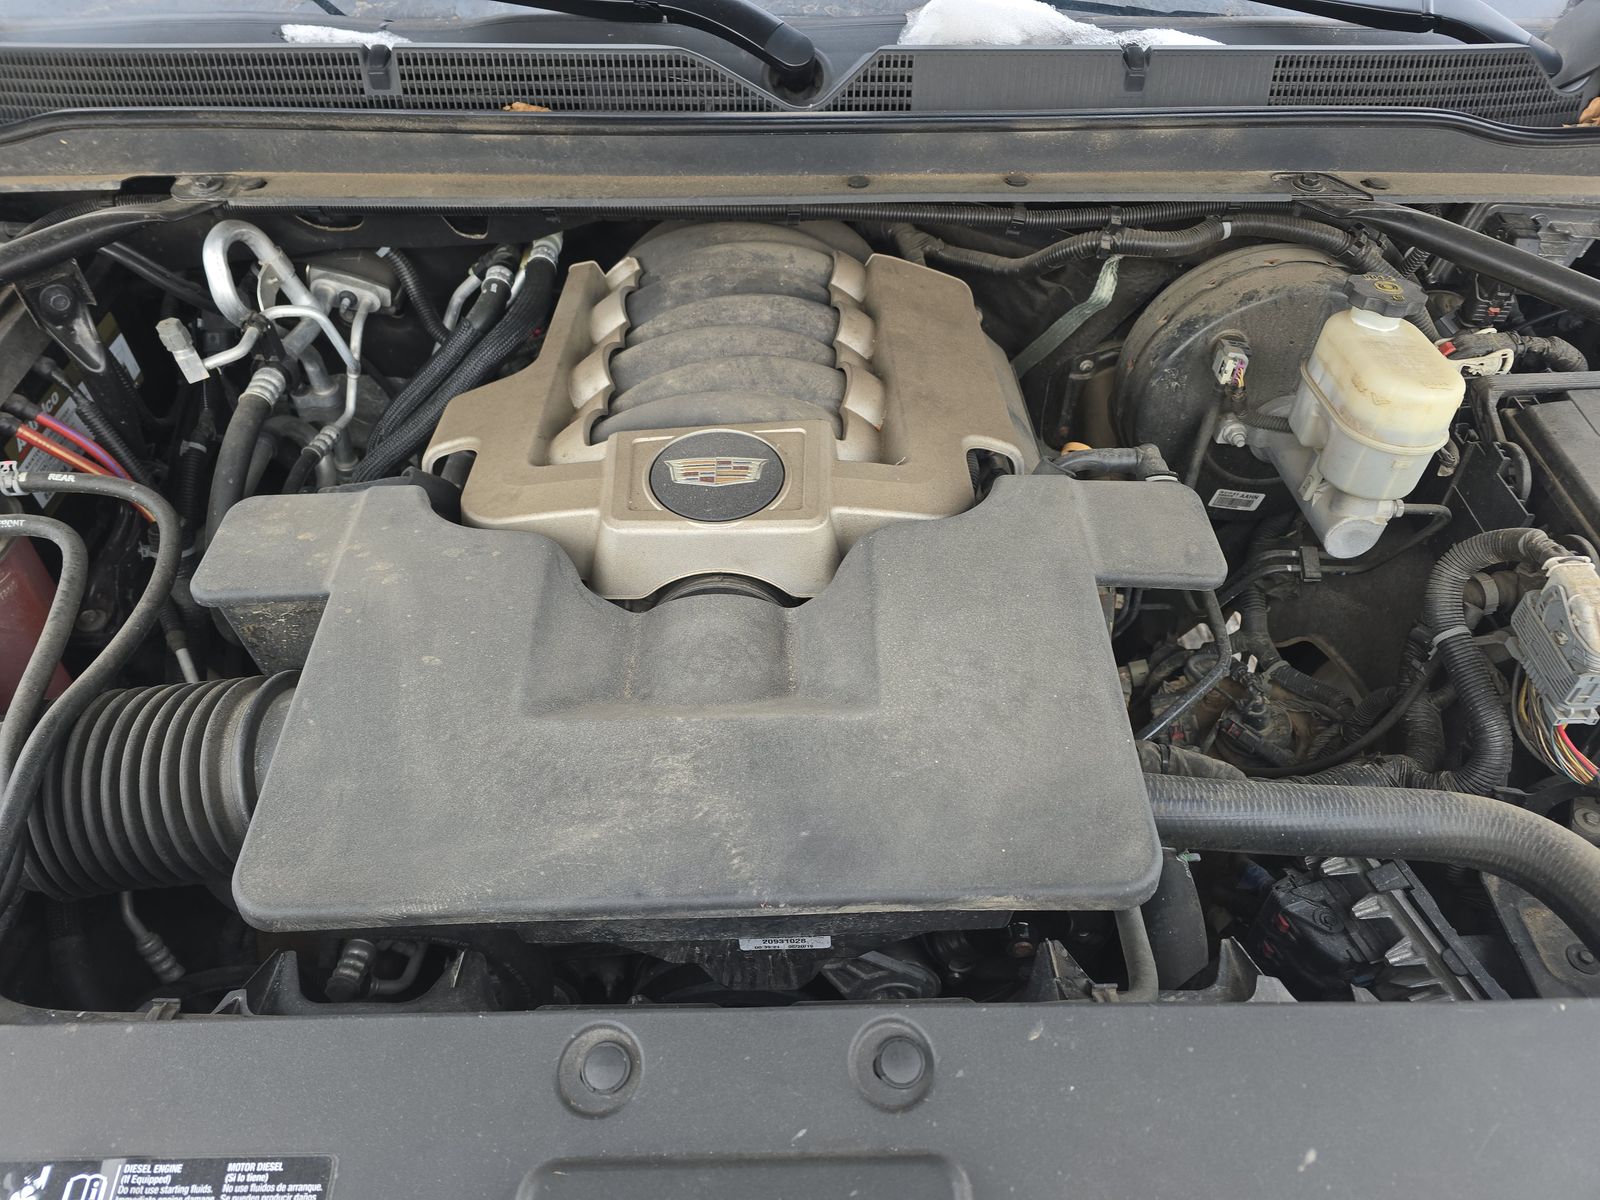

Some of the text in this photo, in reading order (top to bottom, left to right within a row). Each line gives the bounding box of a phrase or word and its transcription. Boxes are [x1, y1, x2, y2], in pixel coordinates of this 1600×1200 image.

[48, 473, 75, 482] REAR
[0, 519, 27, 528] RONT
[123, 1163, 184, 1174] DIESEL ENGINE
[227, 1161, 283, 1172] MOTOR DIESEL
[120, 1174, 172, 1186] (If Equipped)
[224, 1172, 269, 1184] (Si lo tiene)
[117, 1184, 213, 1196] Do not use starting fluids.
[222, 1182, 323, 1193] No use fluidos de arranque.
